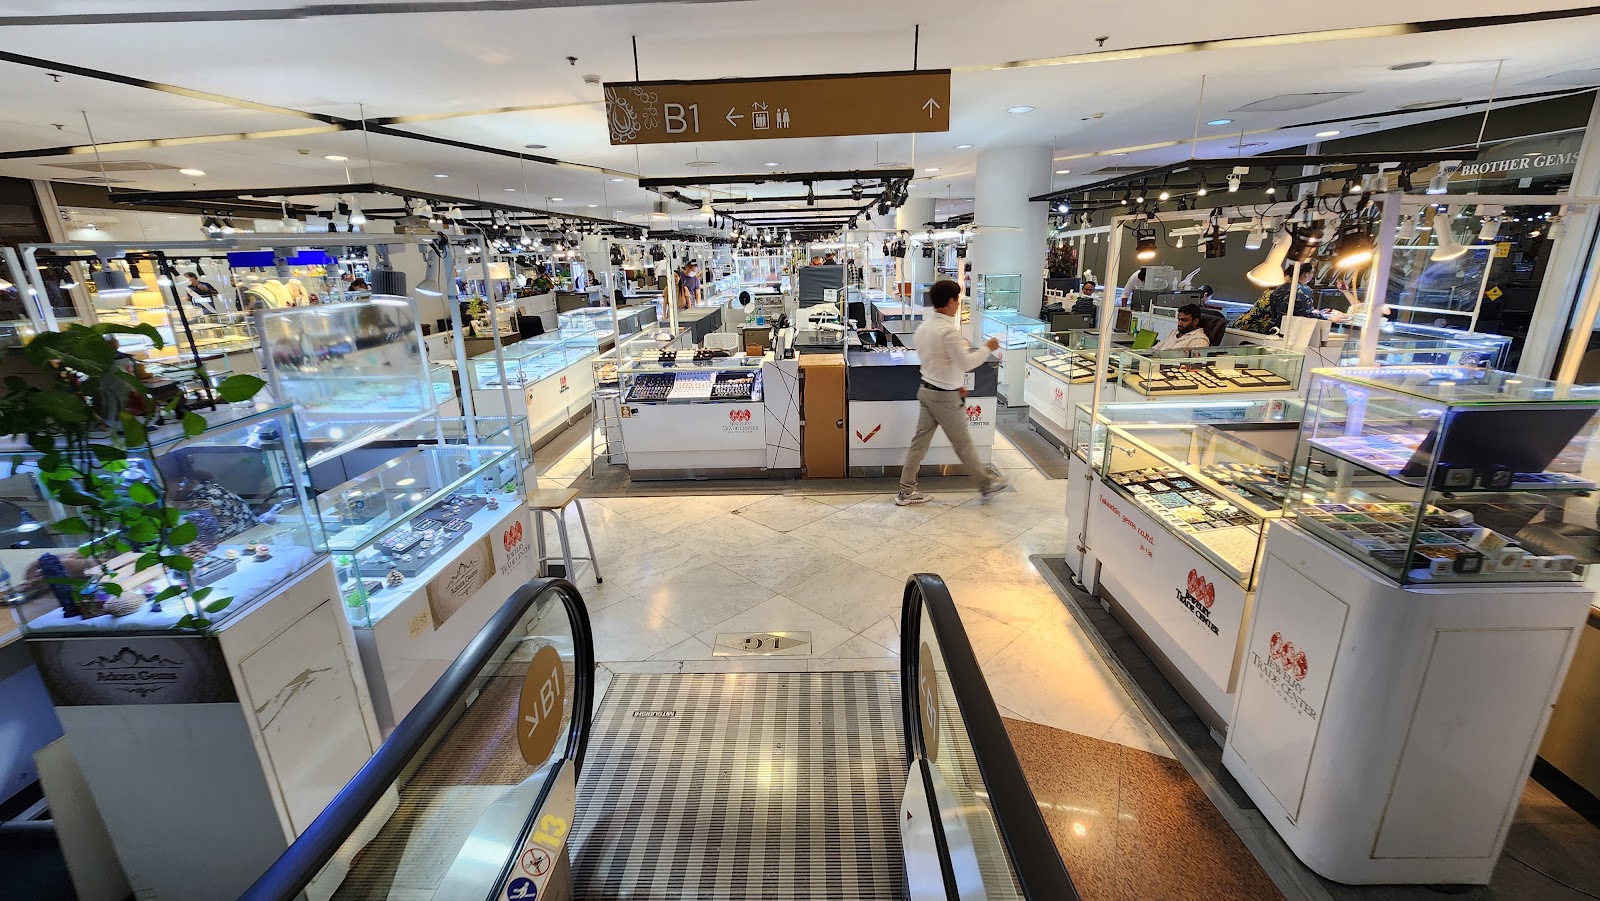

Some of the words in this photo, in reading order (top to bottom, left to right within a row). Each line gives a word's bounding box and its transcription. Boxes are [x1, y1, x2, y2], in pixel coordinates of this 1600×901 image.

[664, 103, 700, 134] B1
[1461, 157, 1530, 176] BROTHER
[1533, 152, 1580, 168] GEMS
[1175, 588, 1195, 614] TRADE
[1195, 610, 1220, 637] CENTER
[1185, 589, 1212, 618] JEWELRY
[137, 671, 178, 681] Gems
[1252, 651, 1281, 686] TRADE
[1281, 683, 1317, 721] CENTER
[1263, 654, 1306, 695] JEWELRY
[532, 814, 567, 848] 13
